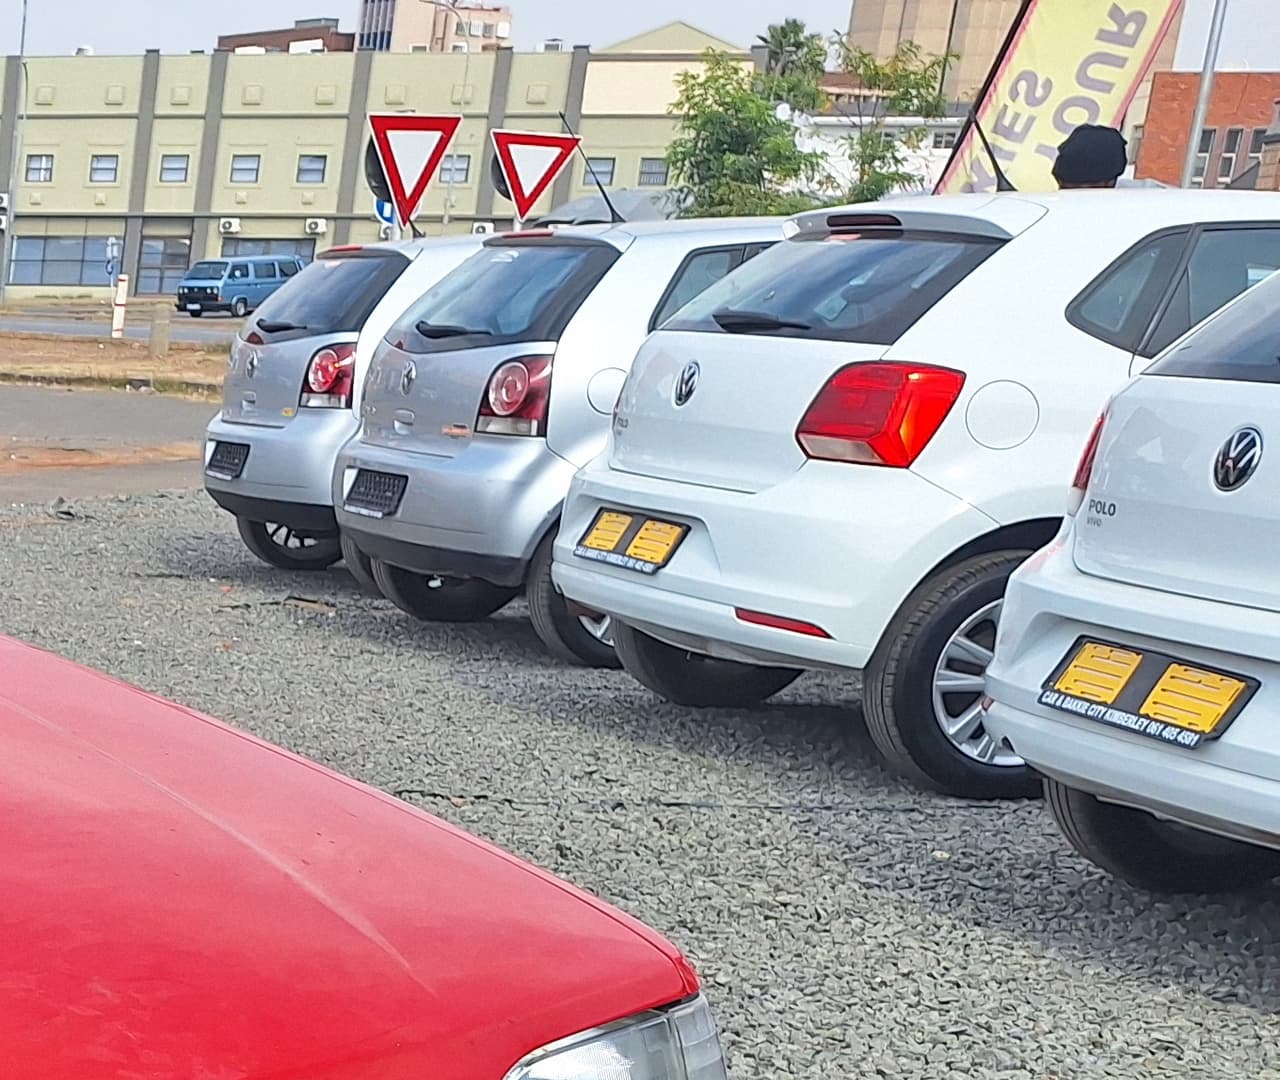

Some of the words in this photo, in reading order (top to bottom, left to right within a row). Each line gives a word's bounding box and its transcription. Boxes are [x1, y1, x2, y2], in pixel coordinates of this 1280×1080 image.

[1089, 498, 1116, 517] POLO
[1087, 703, 1106, 719] CITY
[1103, 708, 1148, 732] KIMBERLEY
